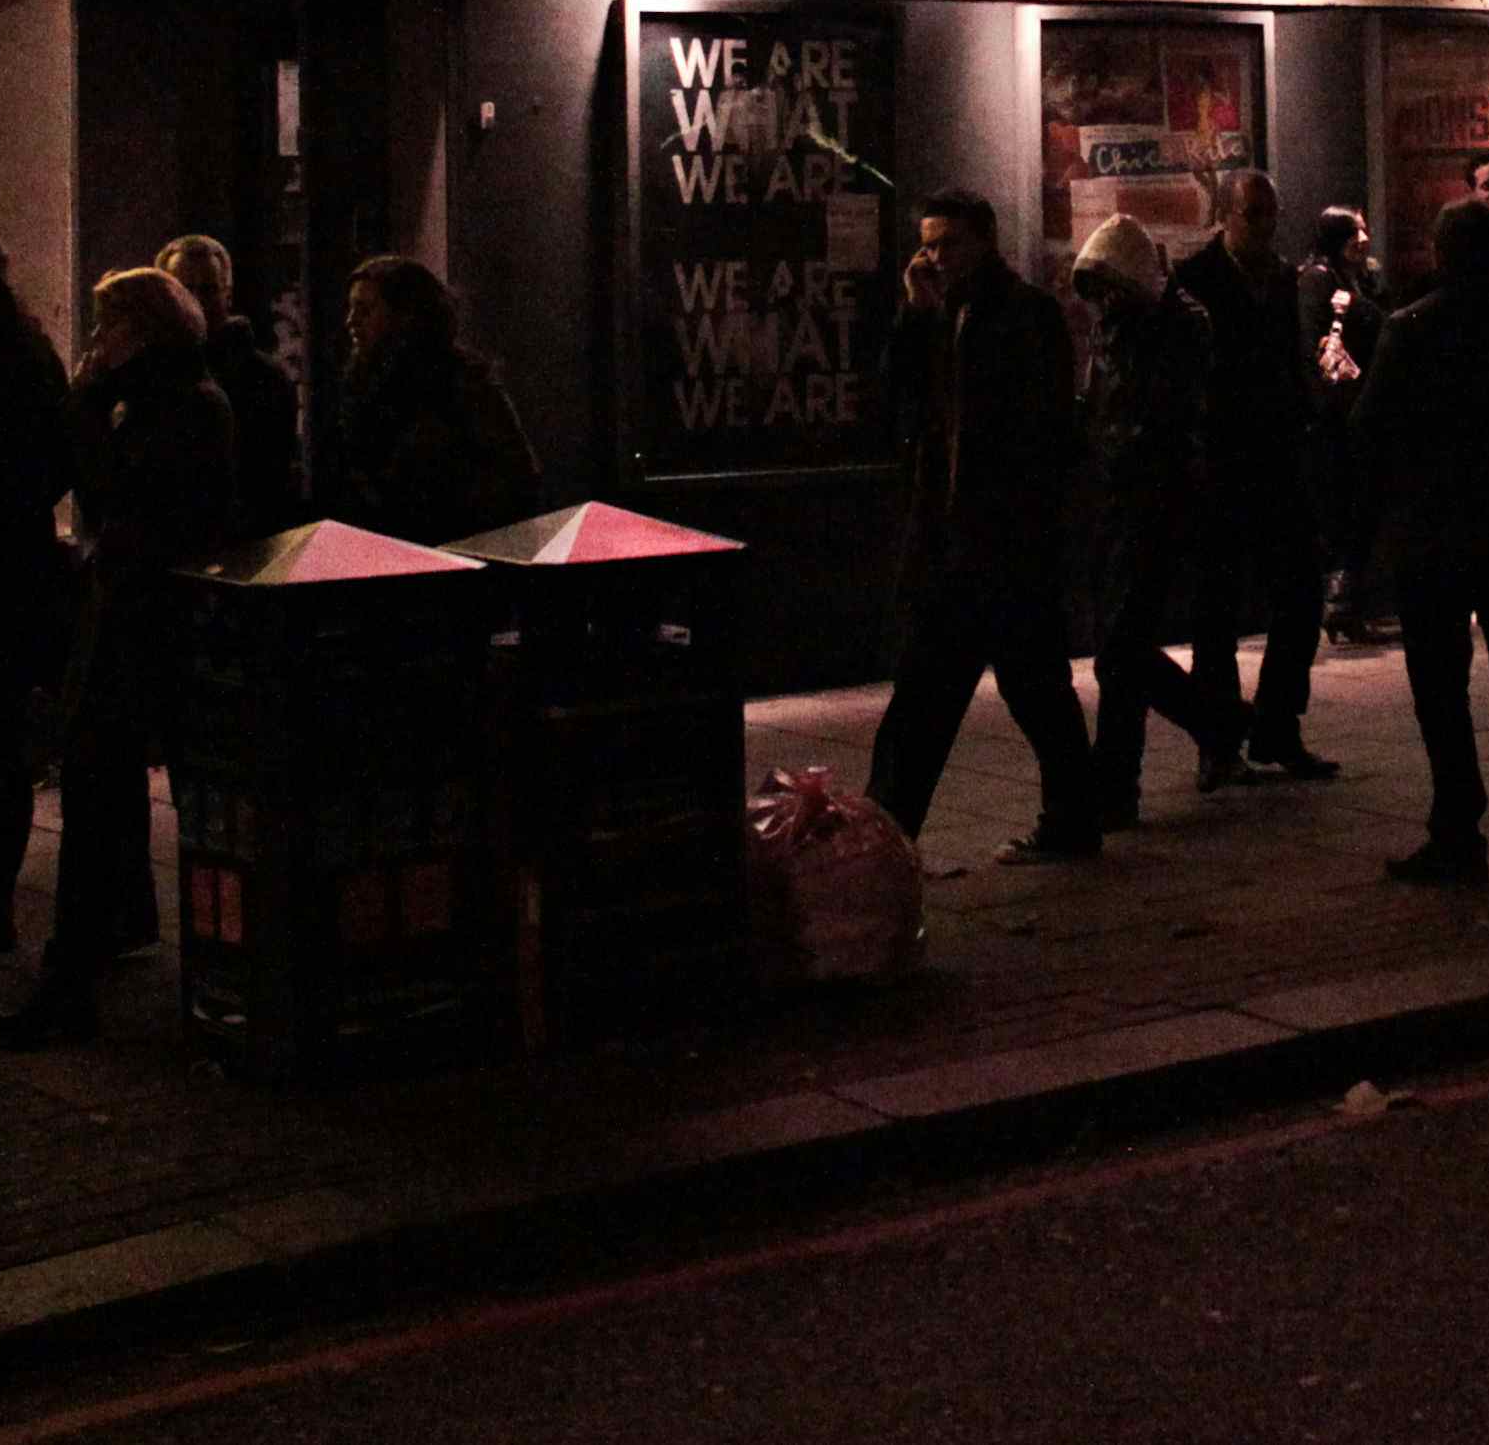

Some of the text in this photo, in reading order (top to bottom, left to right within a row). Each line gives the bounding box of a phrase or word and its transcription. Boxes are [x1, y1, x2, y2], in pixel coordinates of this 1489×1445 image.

[669, 36, 859, 90] WE ARE
[669, 87, 859, 153] WHAT
[671, 154, 855, 205] WE ARE
[671, 258, 858, 313] WE ARE
[671, 309, 859, 378] WHAT
[671, 372, 861, 429] WE ARE
